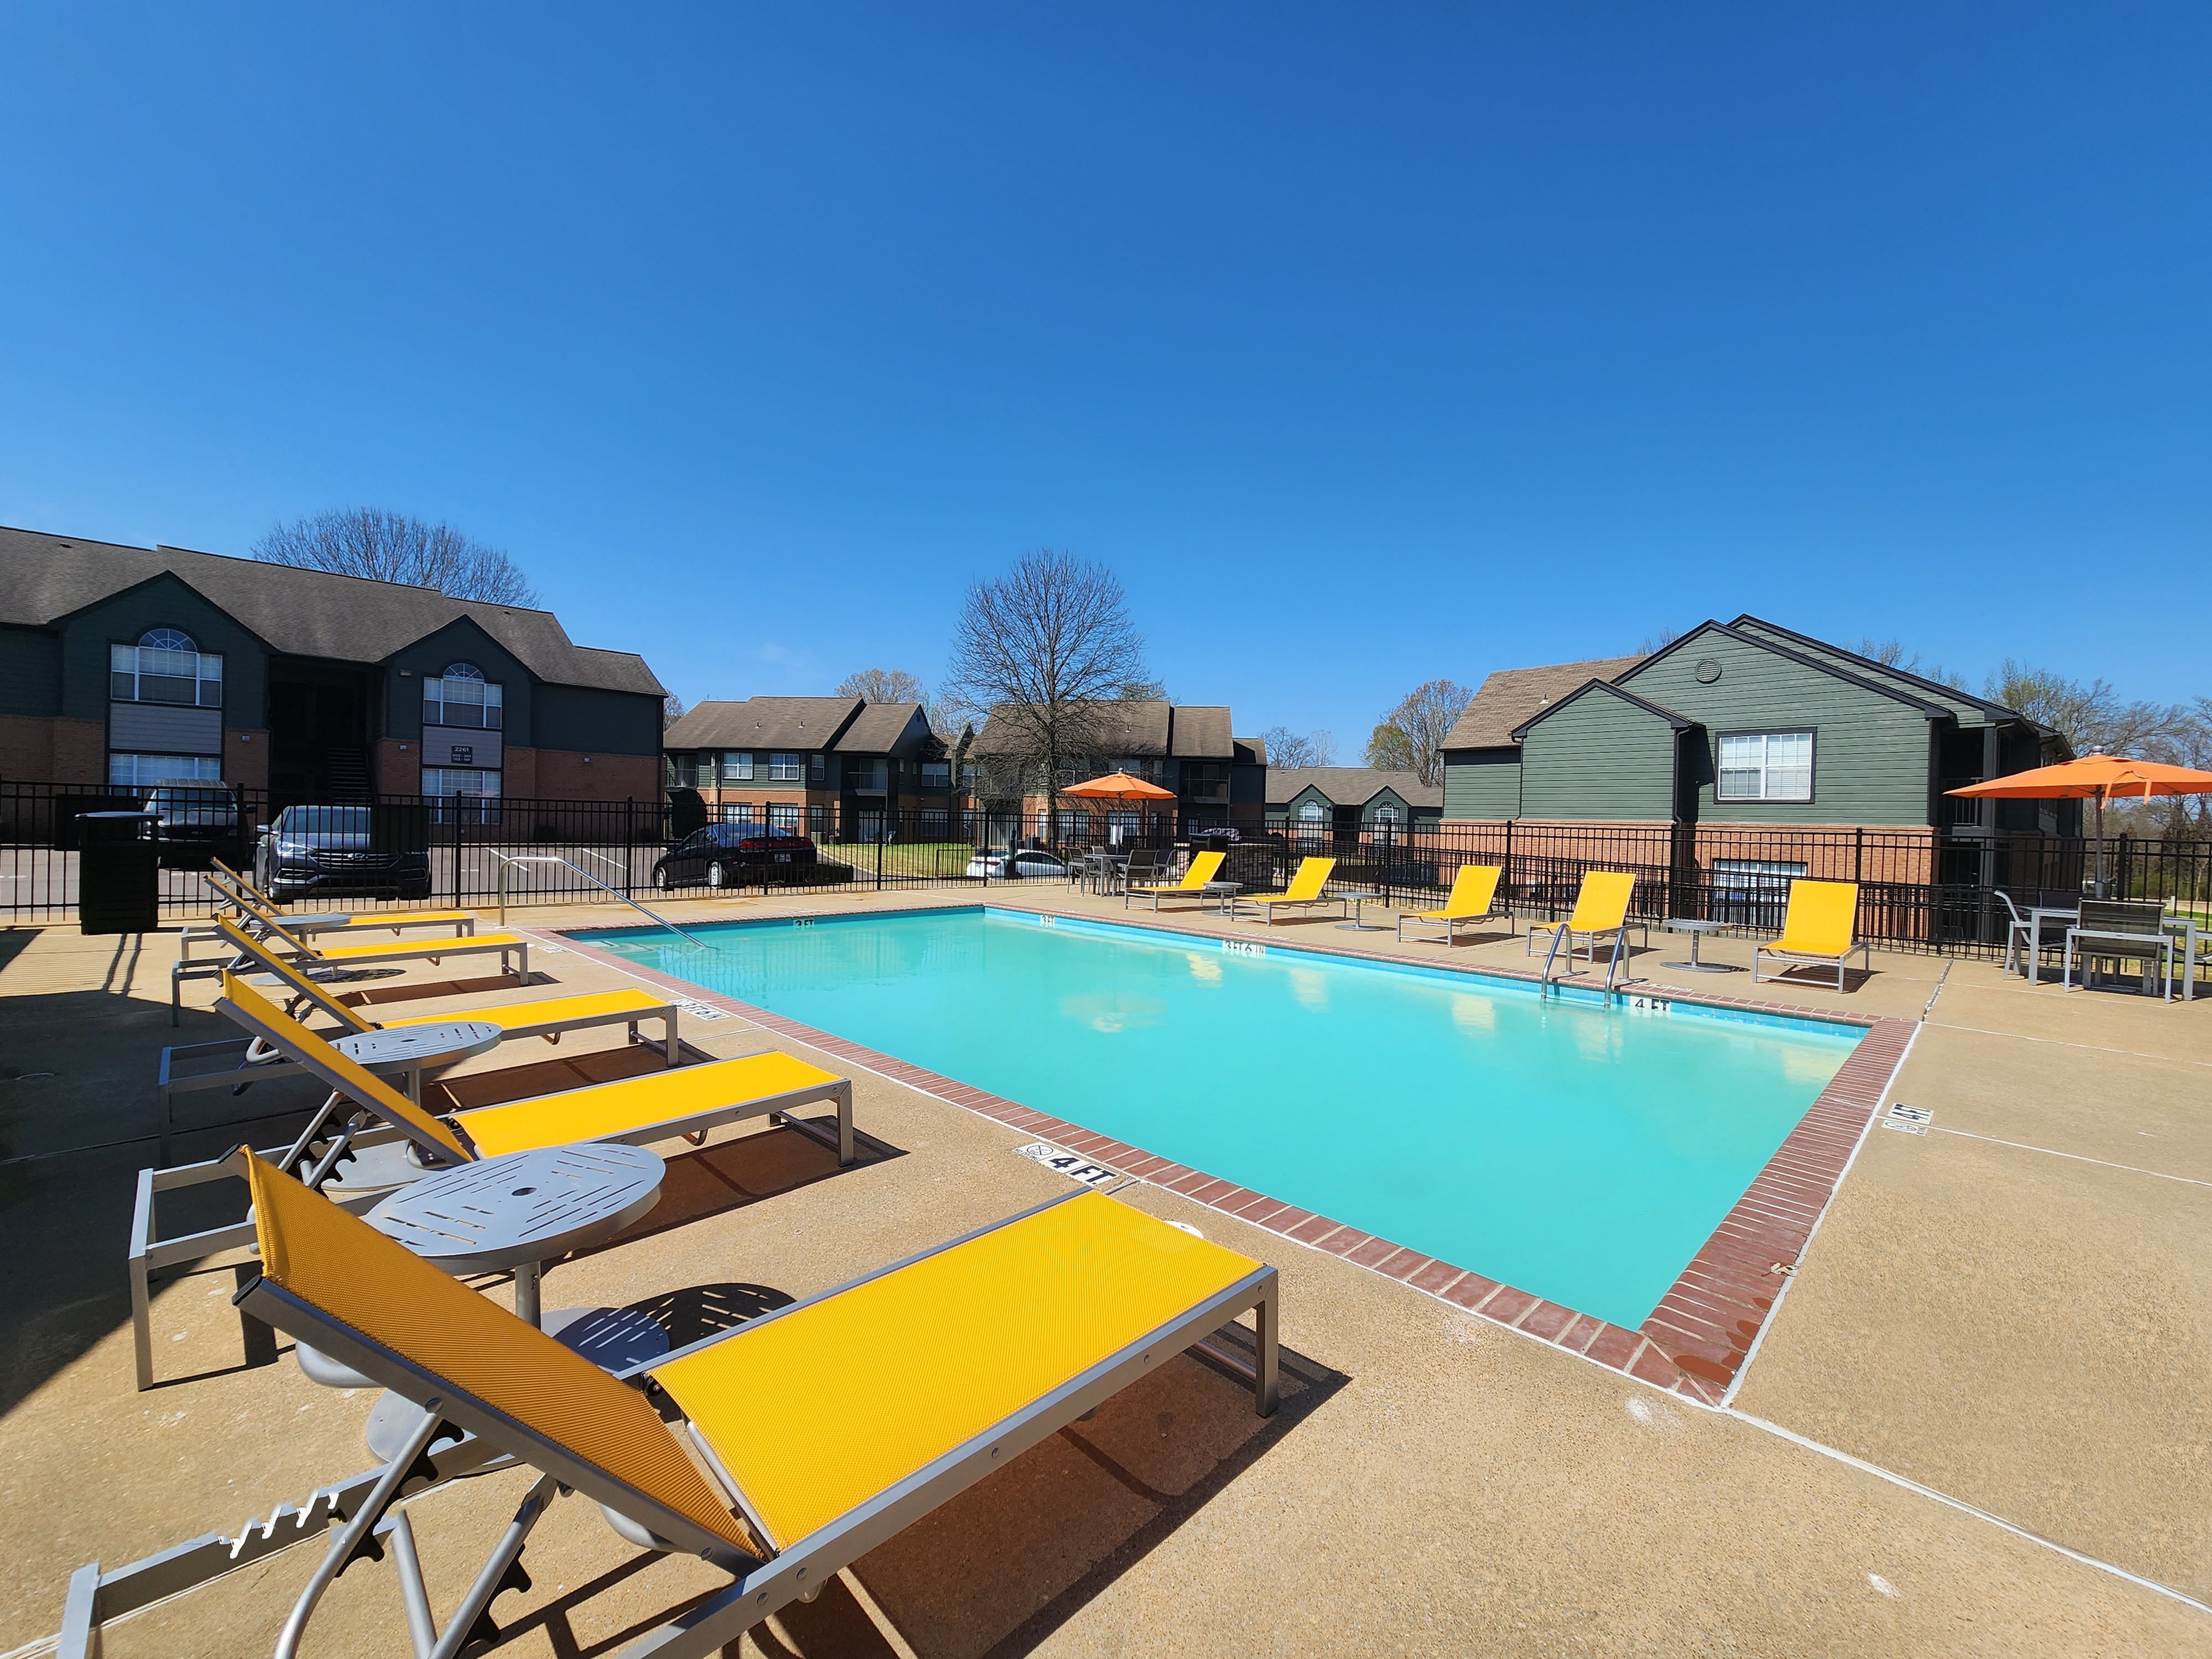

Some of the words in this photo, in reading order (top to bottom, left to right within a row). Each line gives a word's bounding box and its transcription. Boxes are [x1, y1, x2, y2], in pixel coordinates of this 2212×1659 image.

[1635, 998, 1645, 1008] 4
[1651, 998, 1670, 1011] FT
[1891, 1111, 1928, 1120] 4
[1048, 1157, 1079, 1169] 4
